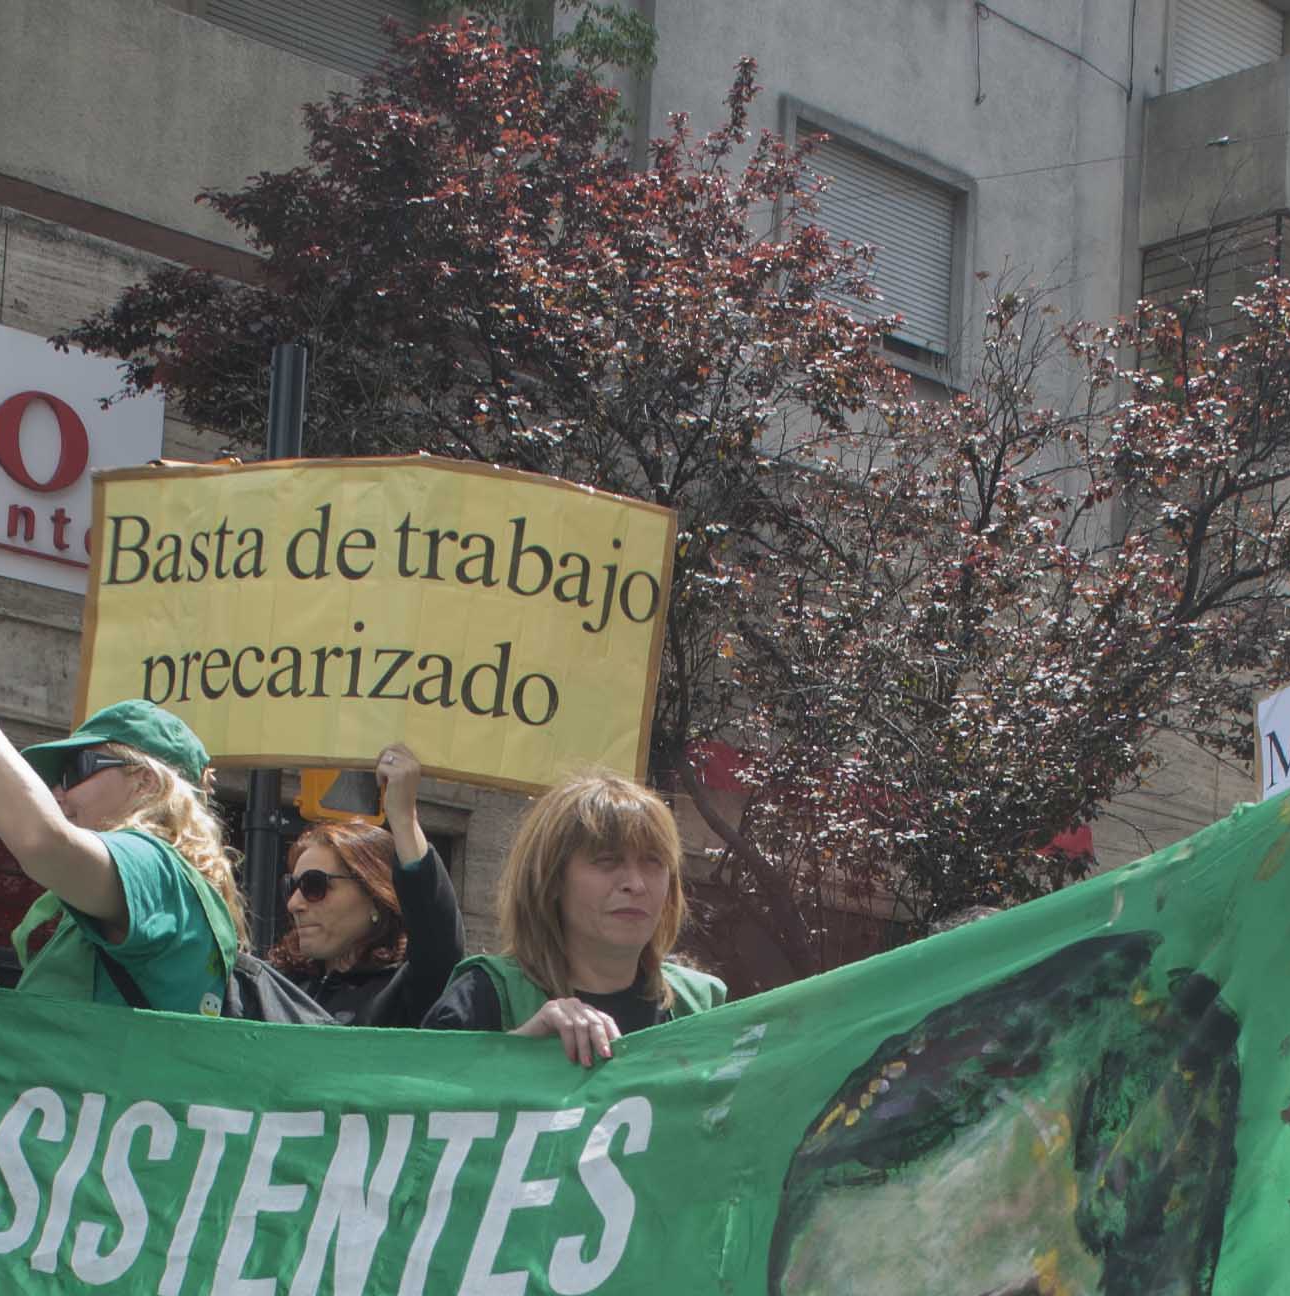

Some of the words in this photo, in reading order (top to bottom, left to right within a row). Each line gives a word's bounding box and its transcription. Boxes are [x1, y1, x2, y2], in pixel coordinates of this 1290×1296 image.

[101, 513, 265, 587] Basta
[285, 503, 378, 581] de
[395, 509, 662, 633] trabajo
[141, 621, 559, 727] precarizado
